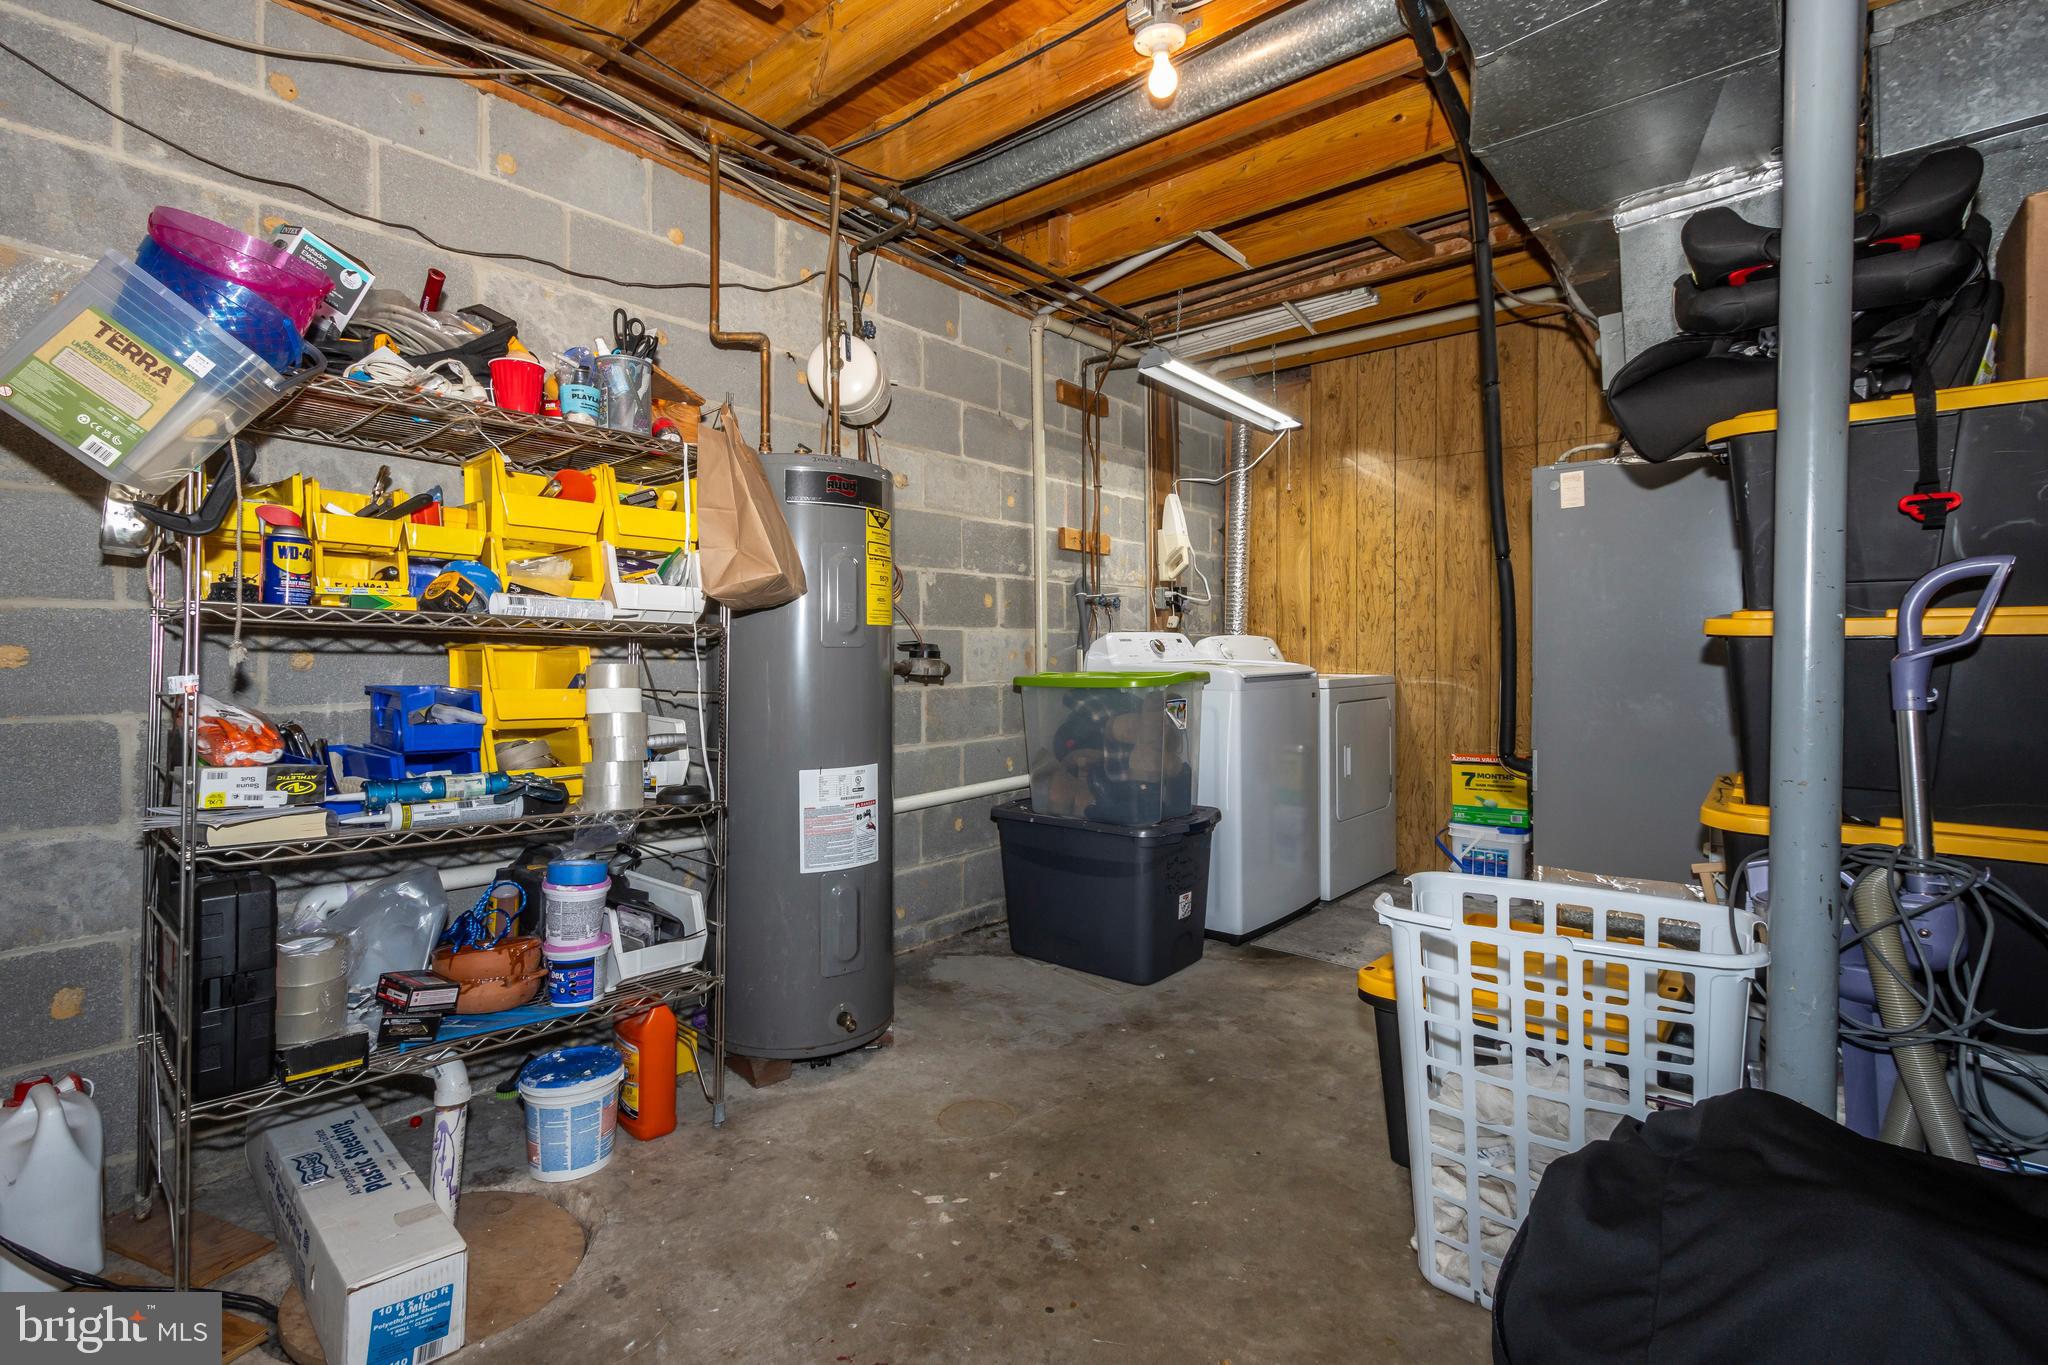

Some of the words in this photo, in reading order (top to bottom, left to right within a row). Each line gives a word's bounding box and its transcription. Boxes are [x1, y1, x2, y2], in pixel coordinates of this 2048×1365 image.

[301, 249, 328, 270] Eléctrico
[304, 244, 328, 262] Inflador
[71, 339, 104, 365] UNIVERS
[83, 340, 130, 375] PREHISTORIC
[94, 320, 172, 386] TERRA
[827, 480, 857, 492] RUUD
[1461, 772, 1476, 787] 7
[1477, 772, 1515, 781] MONTHS
[329, 1118, 368, 1161] Sheeting
[351, 1156, 392, 1193] Plastic
[378, 1306, 392, 1316] 10
[395, 1302, 405, 1311] ft
[418, 1290, 438, 1303] 100
[440, 1285, 449, 1296] ft
[408, 1301, 429, 1314] MIL
[373, 1312, 419, 1331] Polyethylene
[420, 1300, 451, 1314] Sheeting
